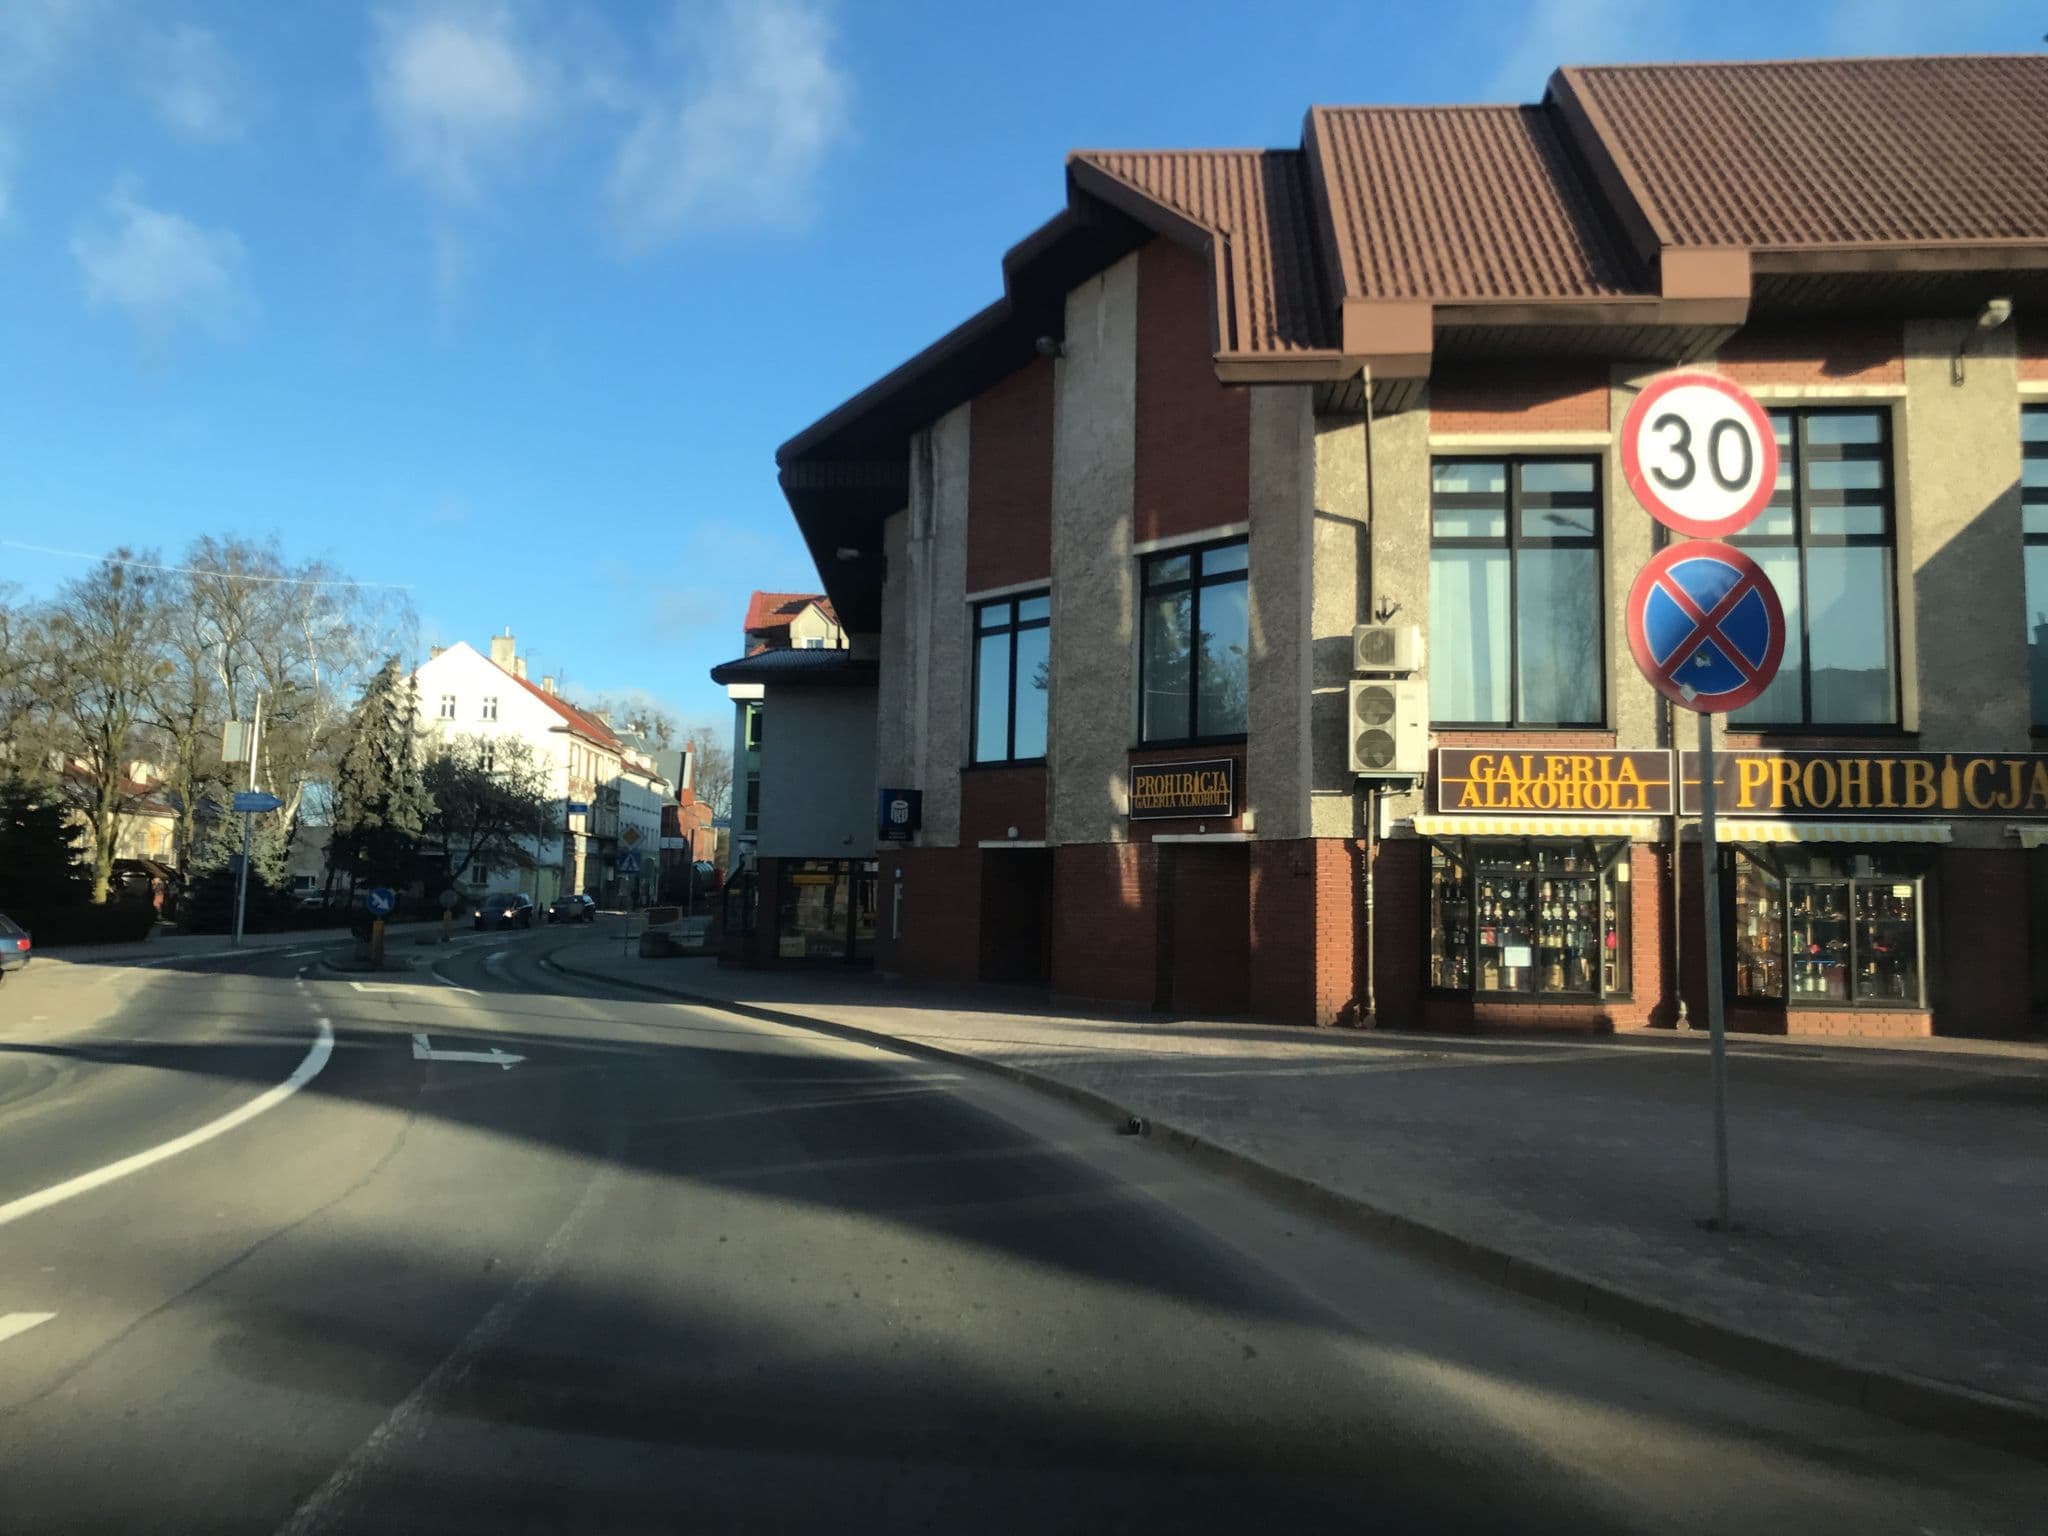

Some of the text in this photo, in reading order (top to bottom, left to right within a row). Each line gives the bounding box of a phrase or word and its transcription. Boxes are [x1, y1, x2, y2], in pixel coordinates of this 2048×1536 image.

[1651, 413, 1753, 492] 30
[1469, 755, 1640, 783] GALERIA
[1136, 771, 1229, 796] PROHIBICJA
[1458, 781, 1651, 810] ALKOHOLI
[1135, 792, 1228, 808] GALERIA ALKOHOLI
